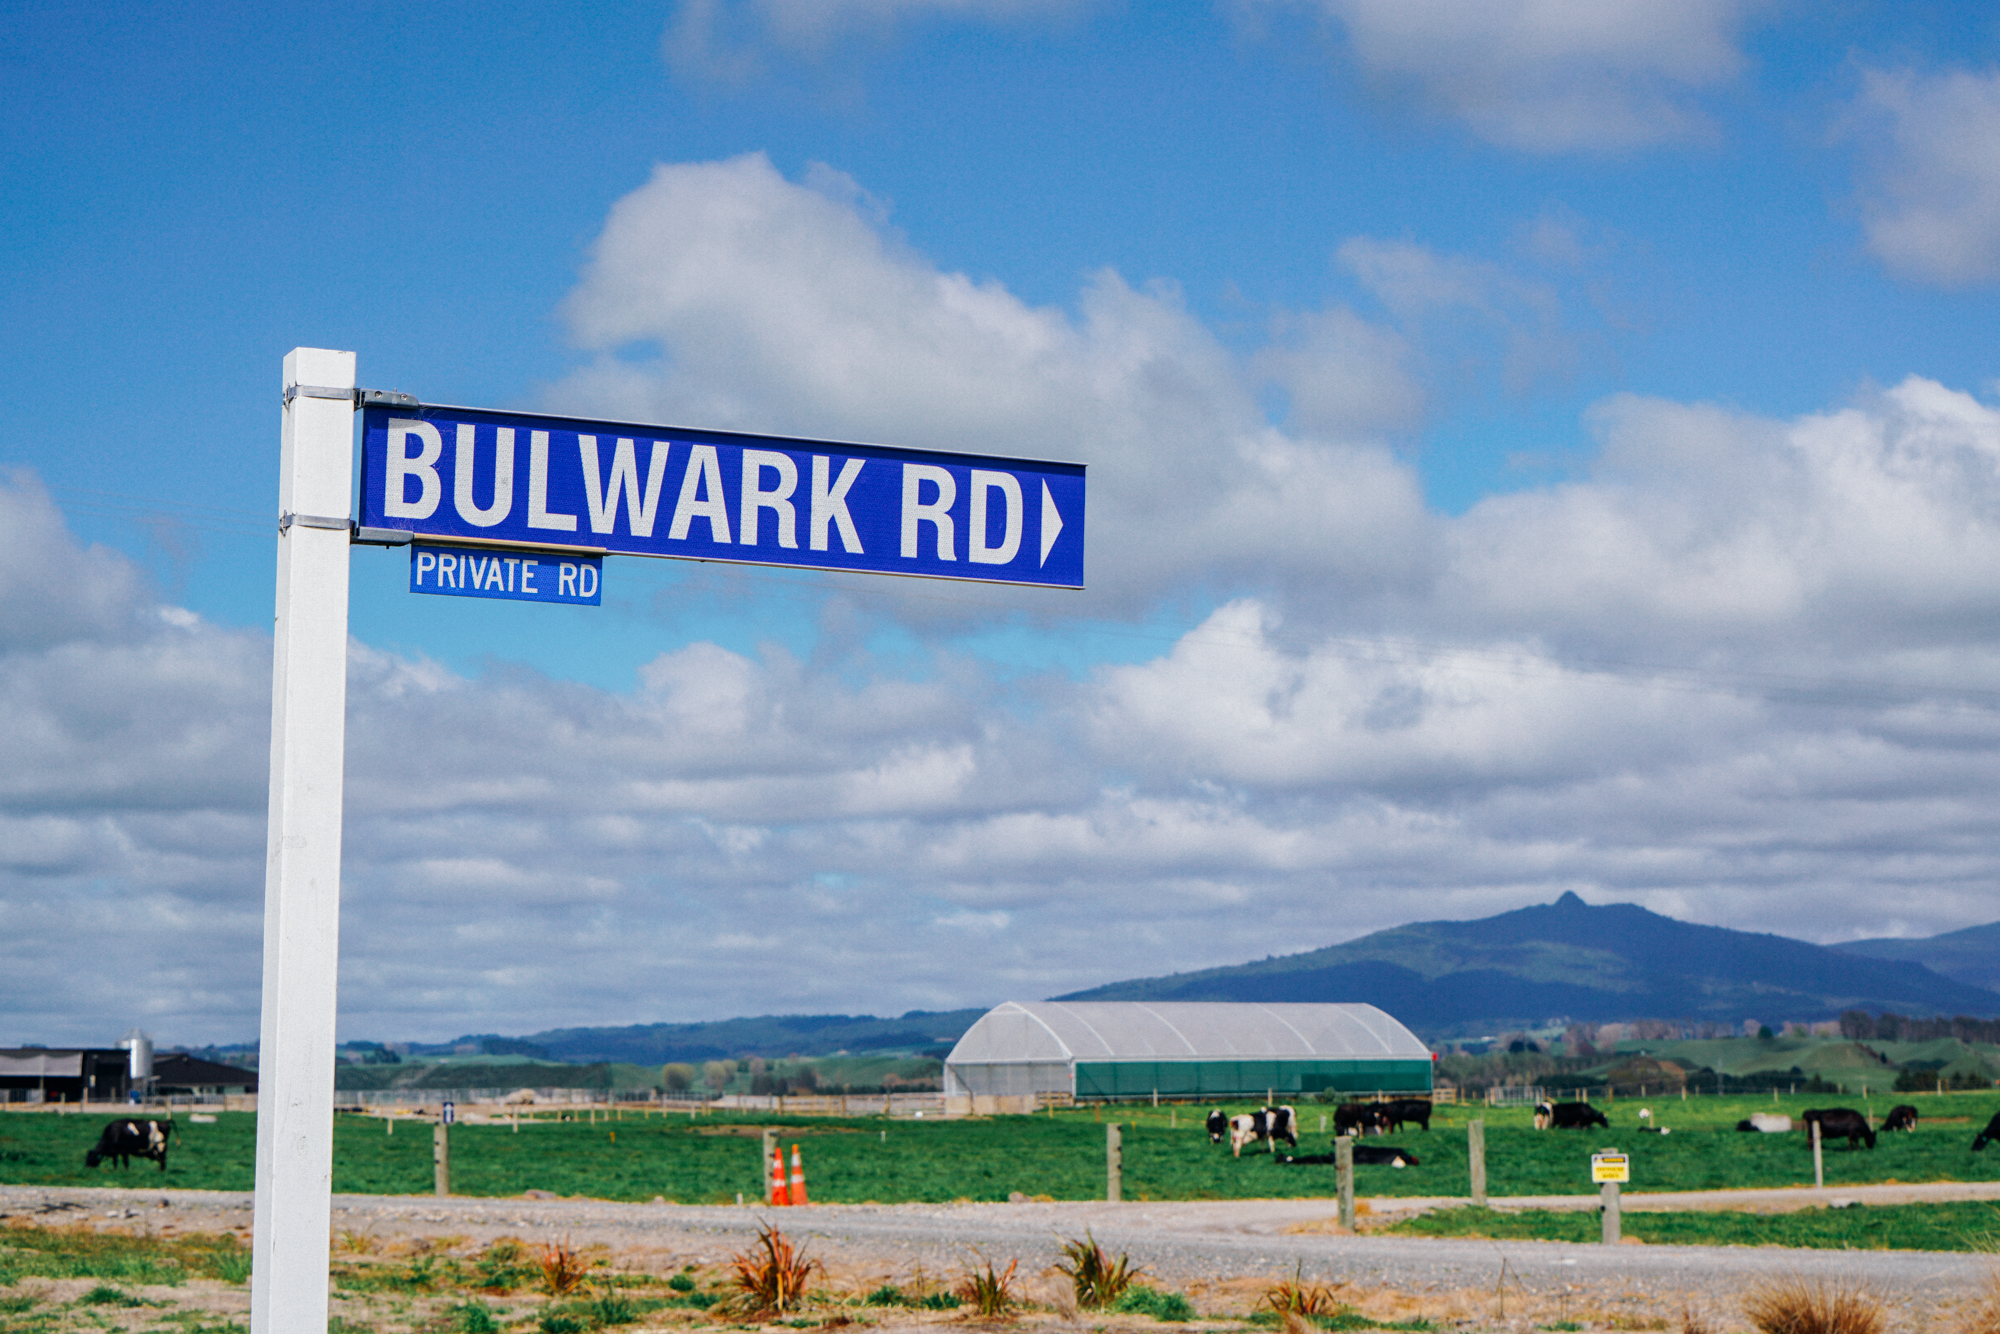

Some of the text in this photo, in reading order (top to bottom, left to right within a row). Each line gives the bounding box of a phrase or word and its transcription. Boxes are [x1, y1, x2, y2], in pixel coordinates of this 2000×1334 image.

[384, 418, 1024, 565] BULWARK RD
[416, 552, 599, 597] PRIVATE RD
